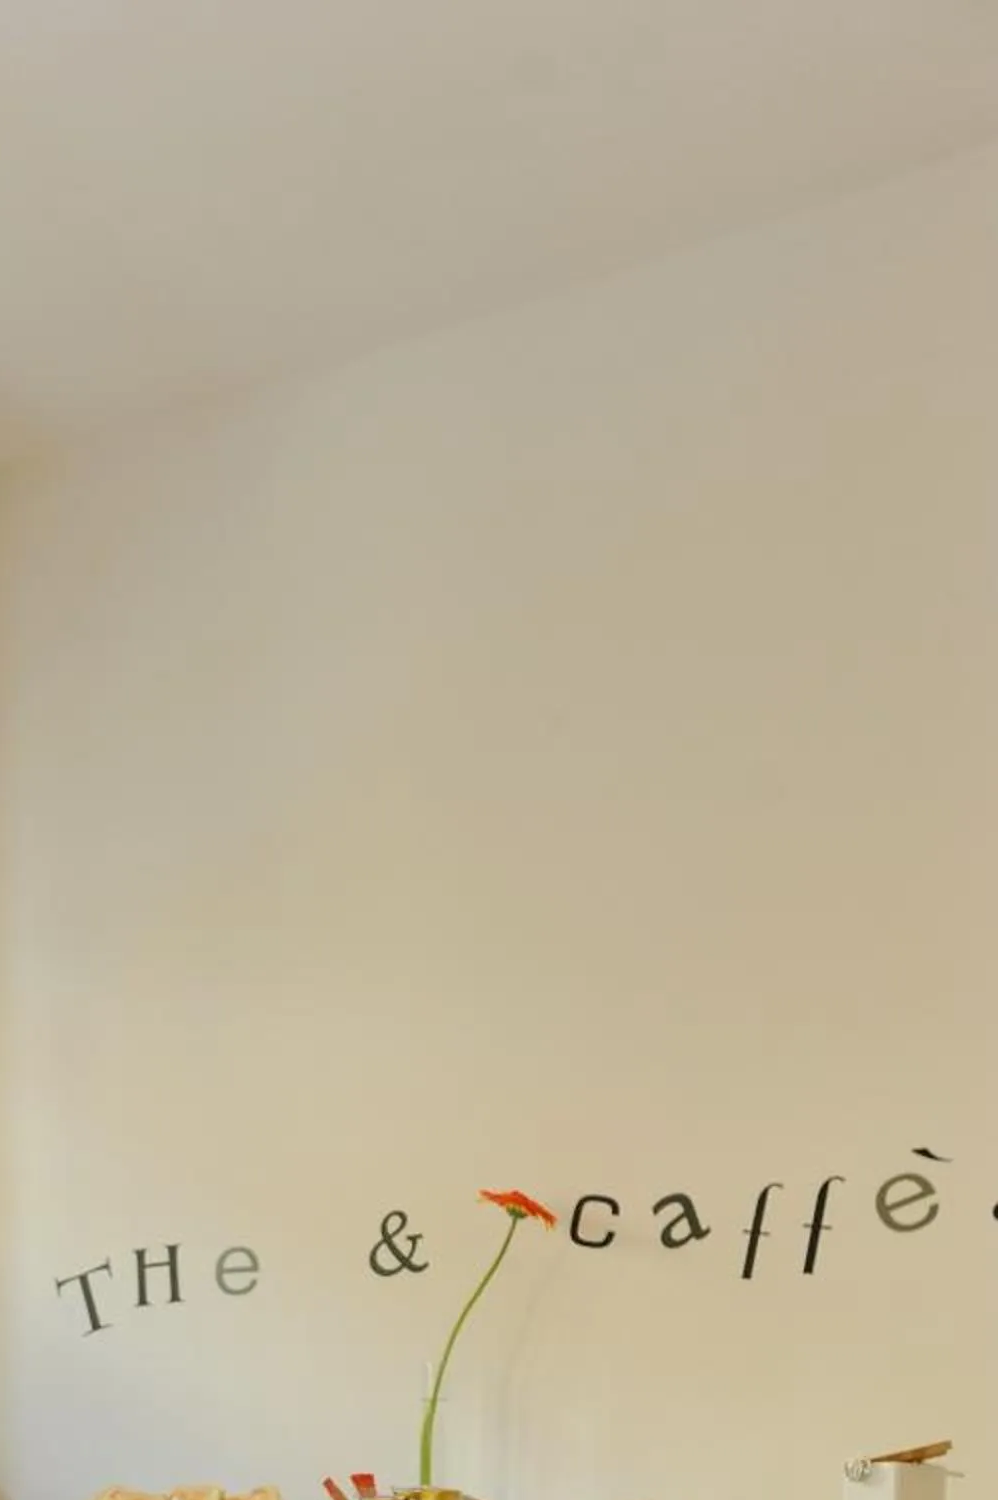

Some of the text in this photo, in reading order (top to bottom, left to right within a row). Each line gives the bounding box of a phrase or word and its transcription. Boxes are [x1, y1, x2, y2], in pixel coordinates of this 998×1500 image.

[54, 1146, 953, 1337] THe & caffè
